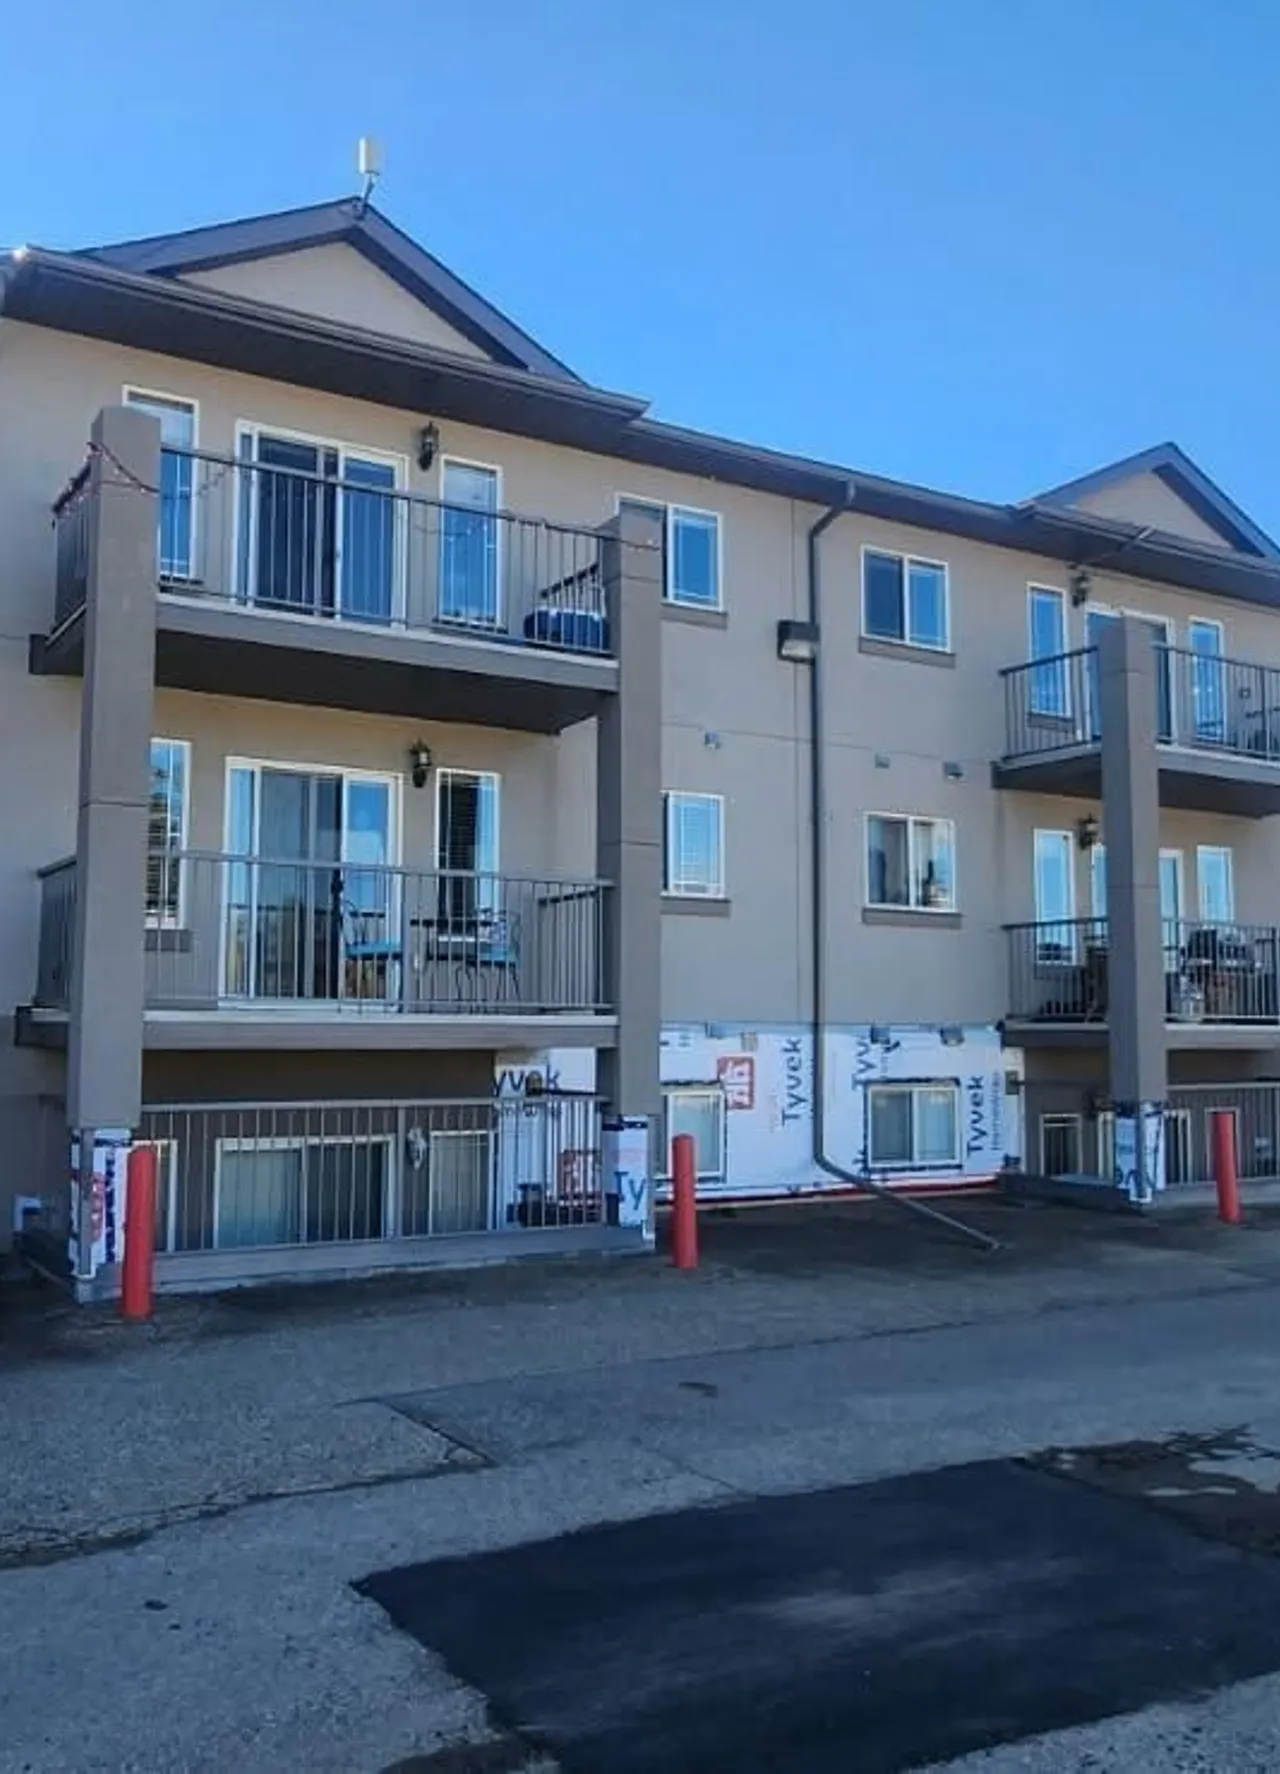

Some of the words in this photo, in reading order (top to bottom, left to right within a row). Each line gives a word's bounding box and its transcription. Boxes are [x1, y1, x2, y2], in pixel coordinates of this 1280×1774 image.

[782, 1038, 809, 1127] Tyvek
[851, 1032, 876, 1092] Tyv
[967, 1076, 987, 1158] Tyvek
